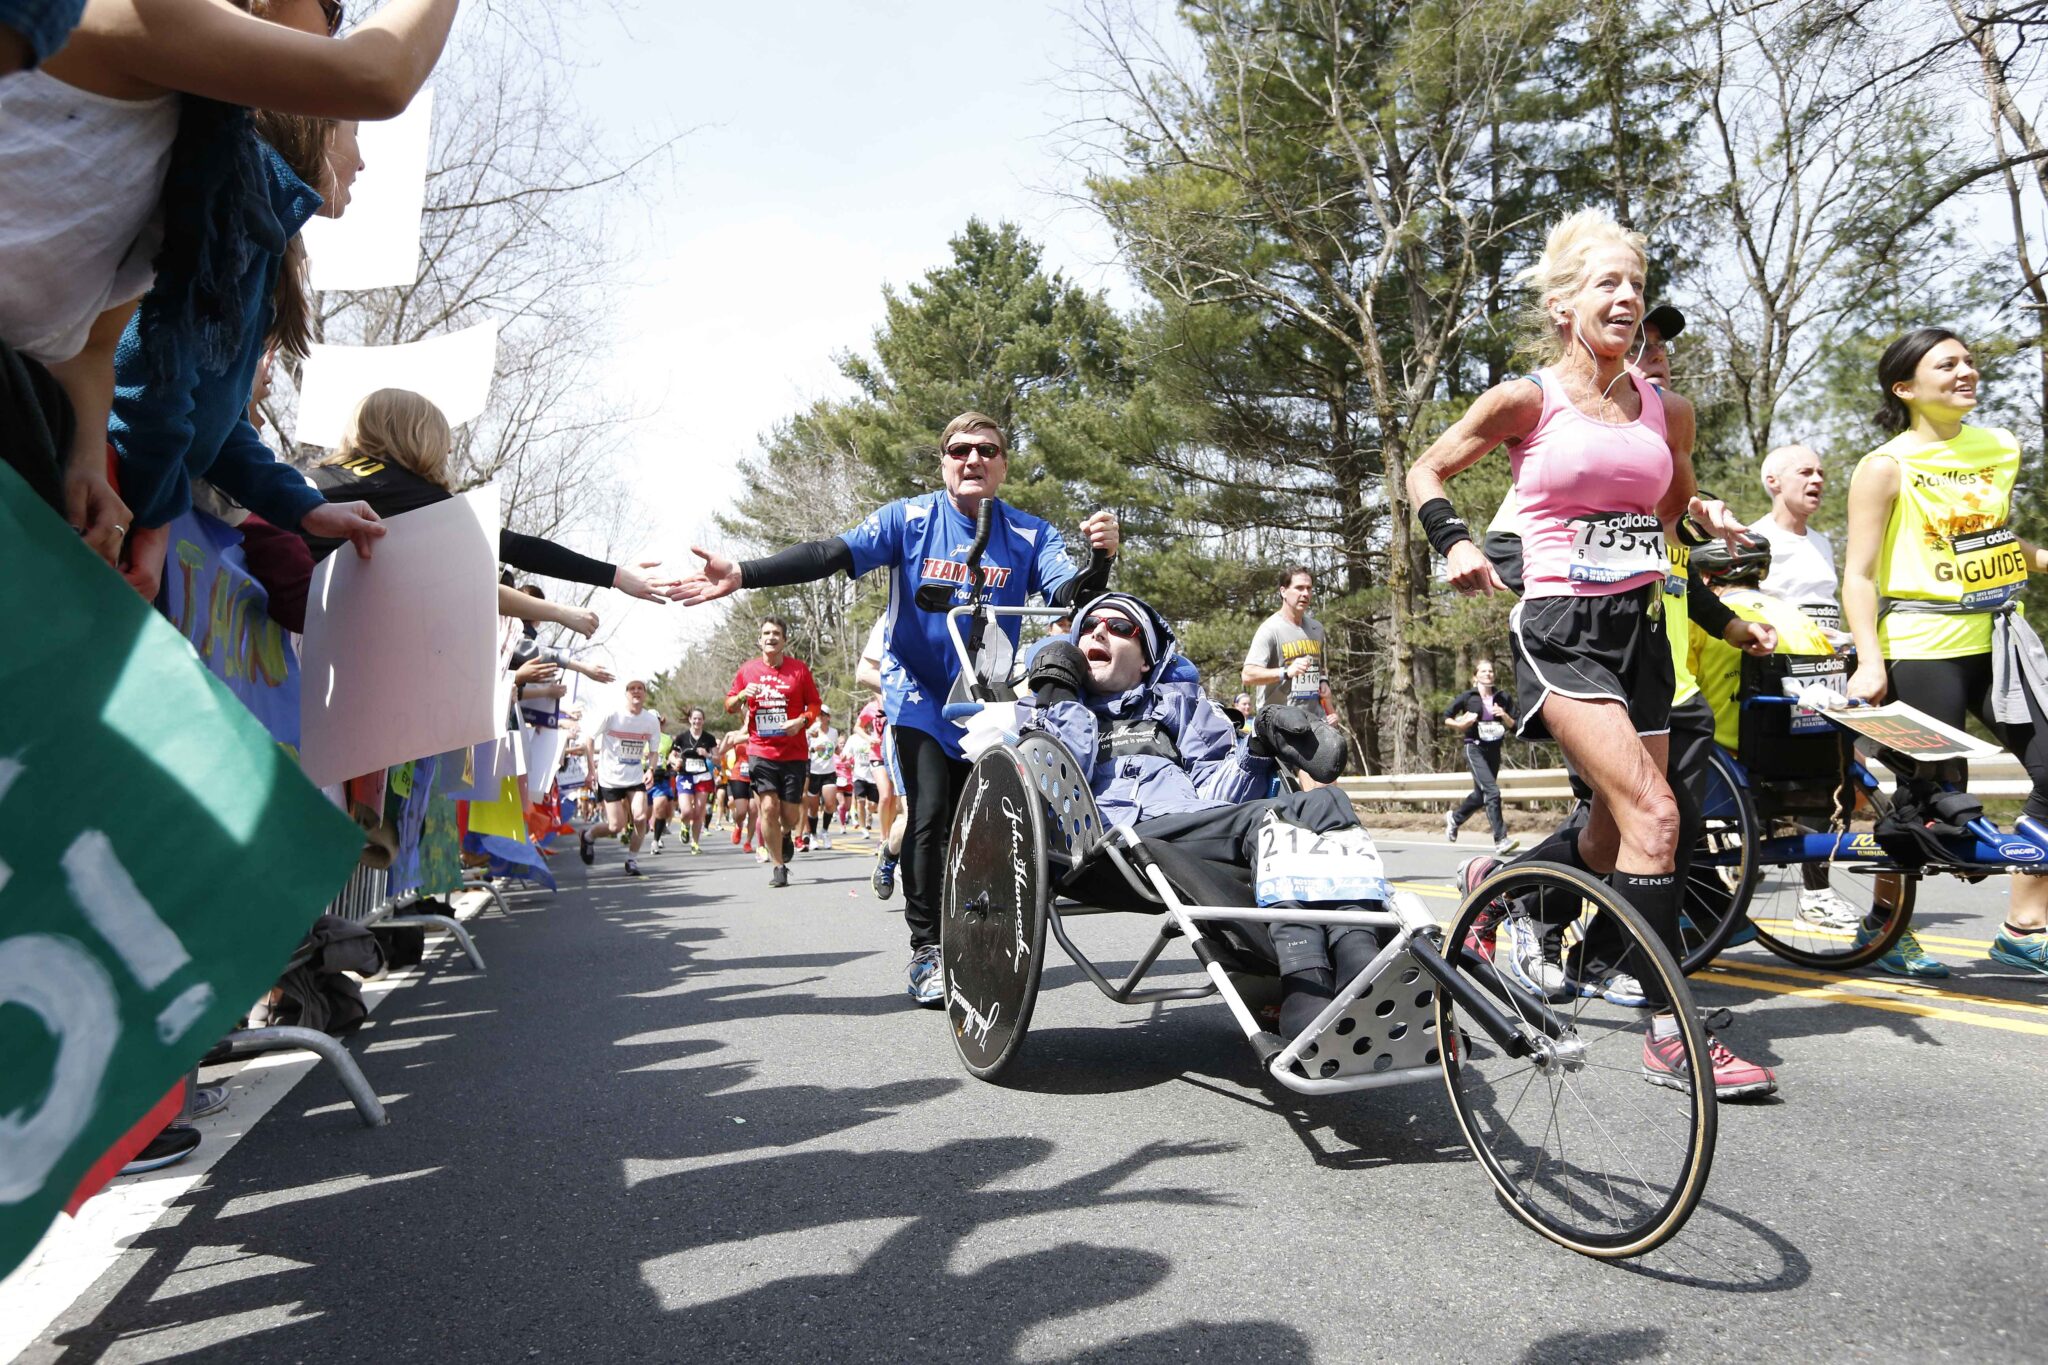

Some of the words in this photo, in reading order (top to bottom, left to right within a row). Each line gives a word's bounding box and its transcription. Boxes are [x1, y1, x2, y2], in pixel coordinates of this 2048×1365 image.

[1608, 513, 1658, 529] adidas
[1578, 549, 1585, 559] 5
[921, 558, 969, 584] TEAM
[1964, 550, 2025, 583] GUIDE
[954, 588, 971, 601] You
[1815, 659, 1844, 672] adidas
[757, 714, 786, 724] 11903
[1848, 720, 1921, 736] BILL
[1001, 796, 1024, 858] John
[1265, 863, 1271, 872] 4
[1012, 853, 1030, 975] Hancock
